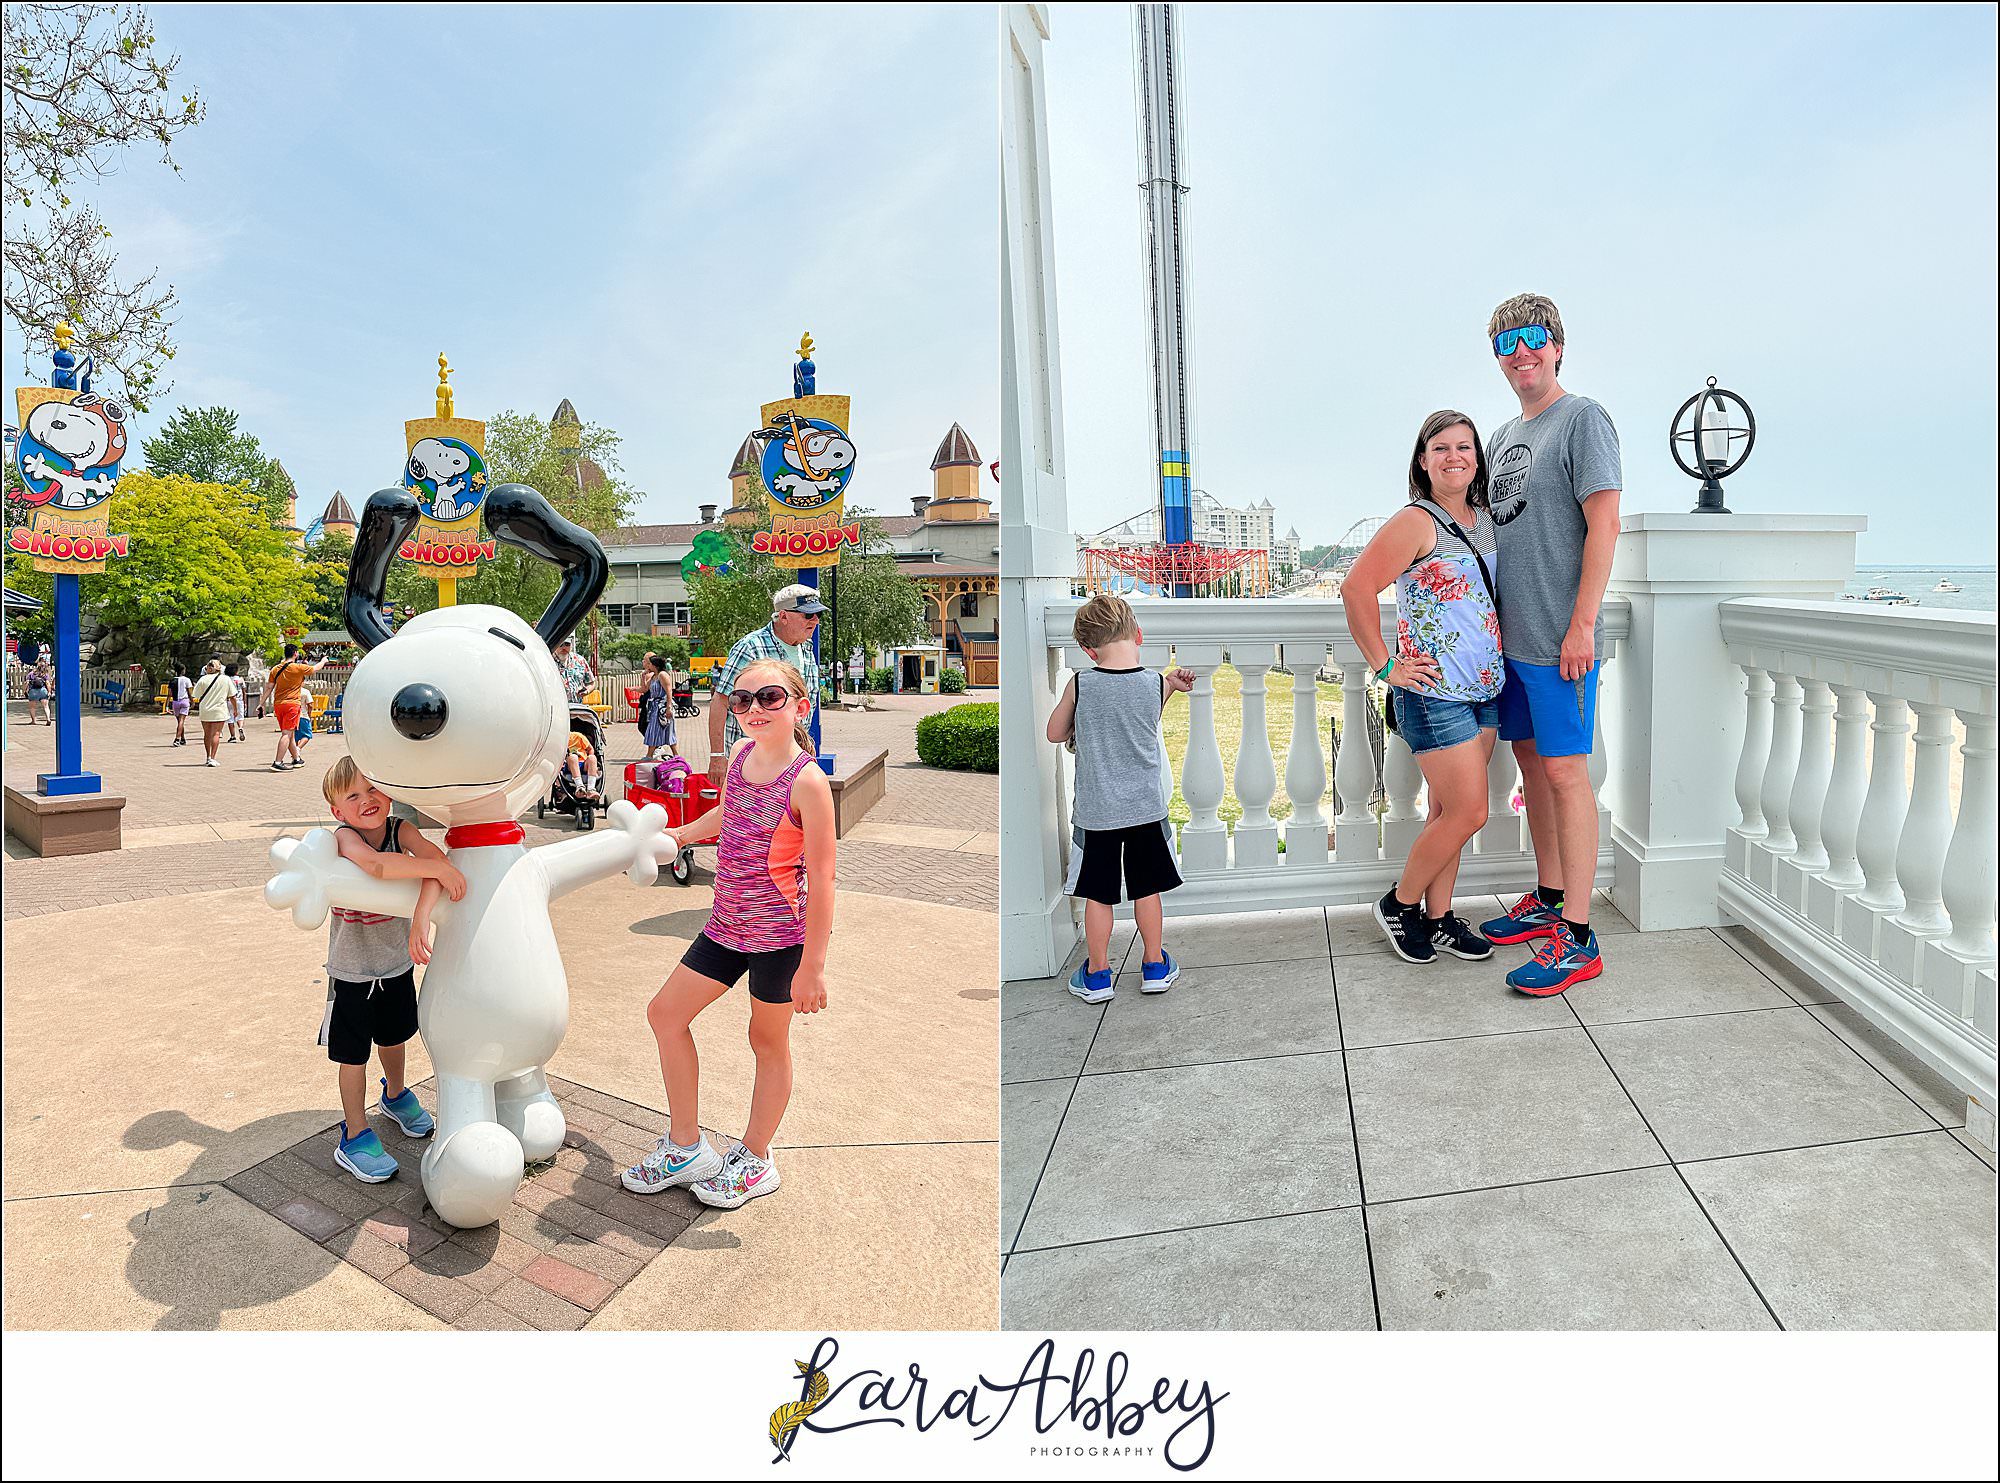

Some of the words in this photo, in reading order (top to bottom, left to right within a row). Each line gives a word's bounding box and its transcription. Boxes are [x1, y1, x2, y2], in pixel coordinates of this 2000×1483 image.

[1494, 482, 1521, 499] THRILLS
[35, 513, 108, 537] Planet
[419, 526, 477, 543] Planet
[773, 512, 838, 533] Planet
[9, 527, 129, 559] SNOOPY
[752, 523, 860, 553] SNOOPY
[399, 540, 496, 564] SNOOPY
